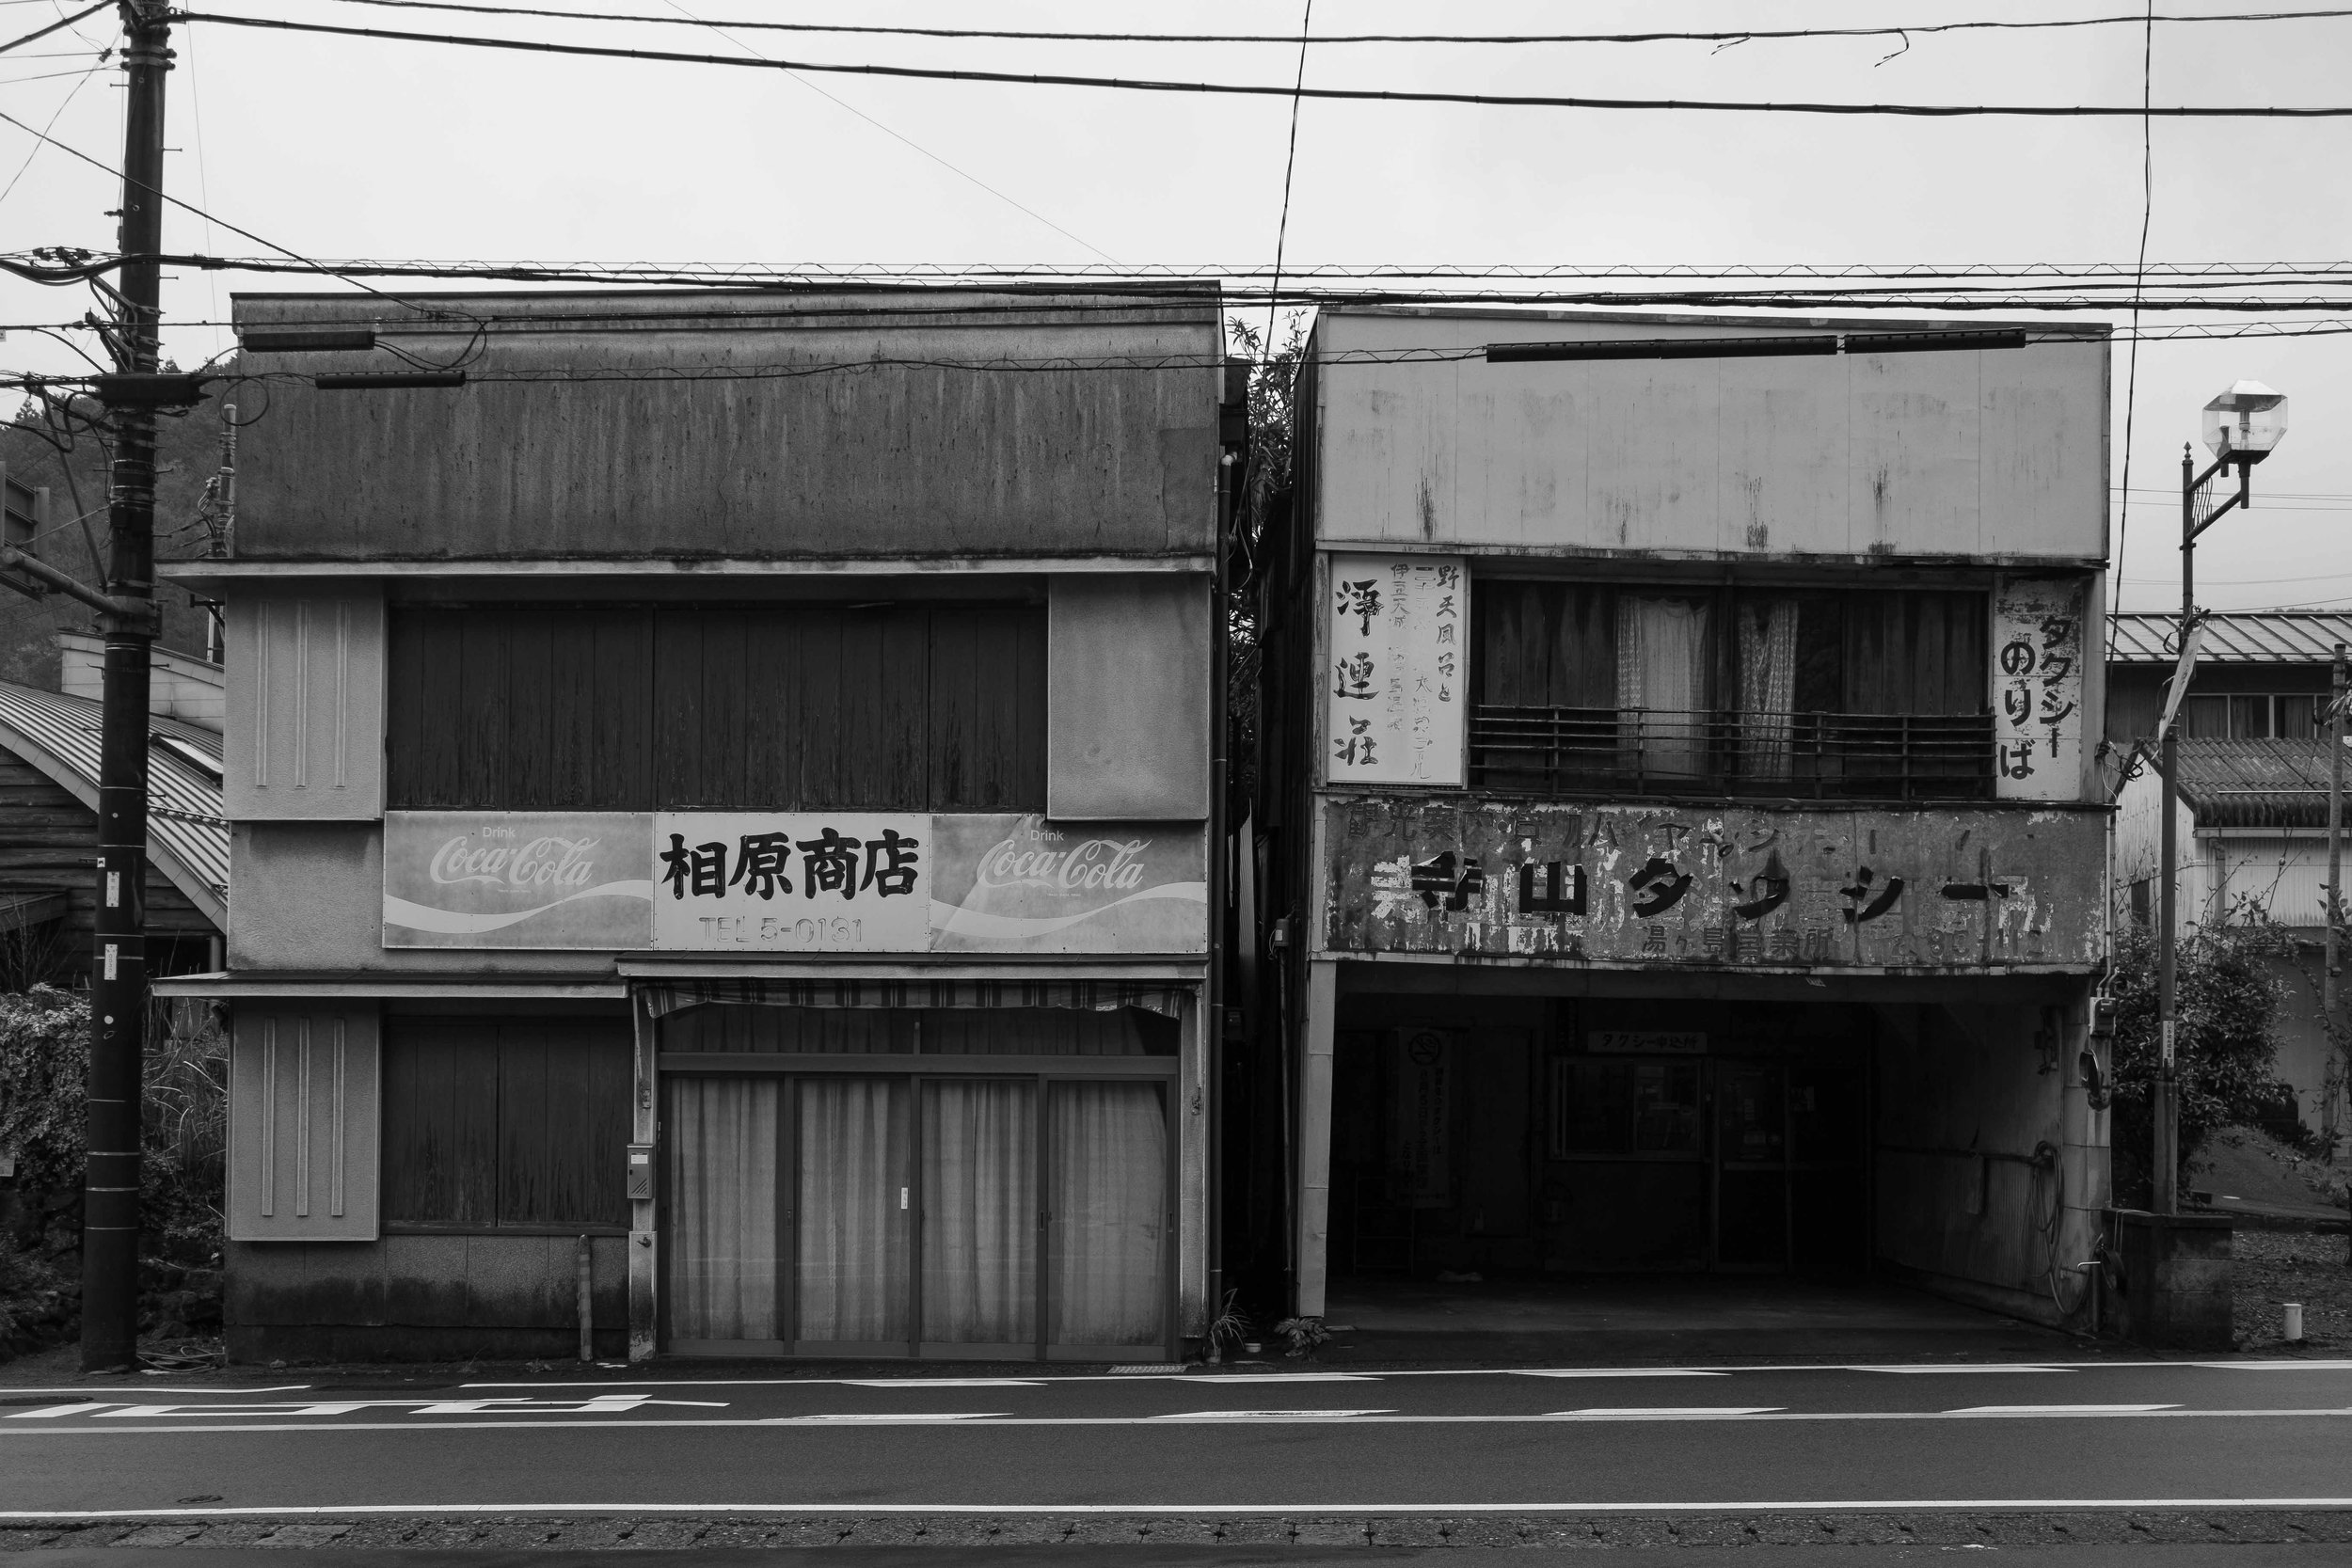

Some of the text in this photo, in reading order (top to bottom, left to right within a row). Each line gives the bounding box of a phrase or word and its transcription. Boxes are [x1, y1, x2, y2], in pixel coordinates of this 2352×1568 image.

[2000, 641, 2036, 780] のりば
[2039, 614, 2074, 758] タクシー
[483, 827, 516, 838] Drink
[1030, 829, 1064, 841] Drink
[429, 835, 602, 886] Coca-Cola
[660, 828, 921, 900] 相原商店
[977, 838, 1152, 889] Coca-Cola
[698, 916, 863, 943] TEL 5-0131
[1602, 1034, 1699, 1050] タクシー申込所
